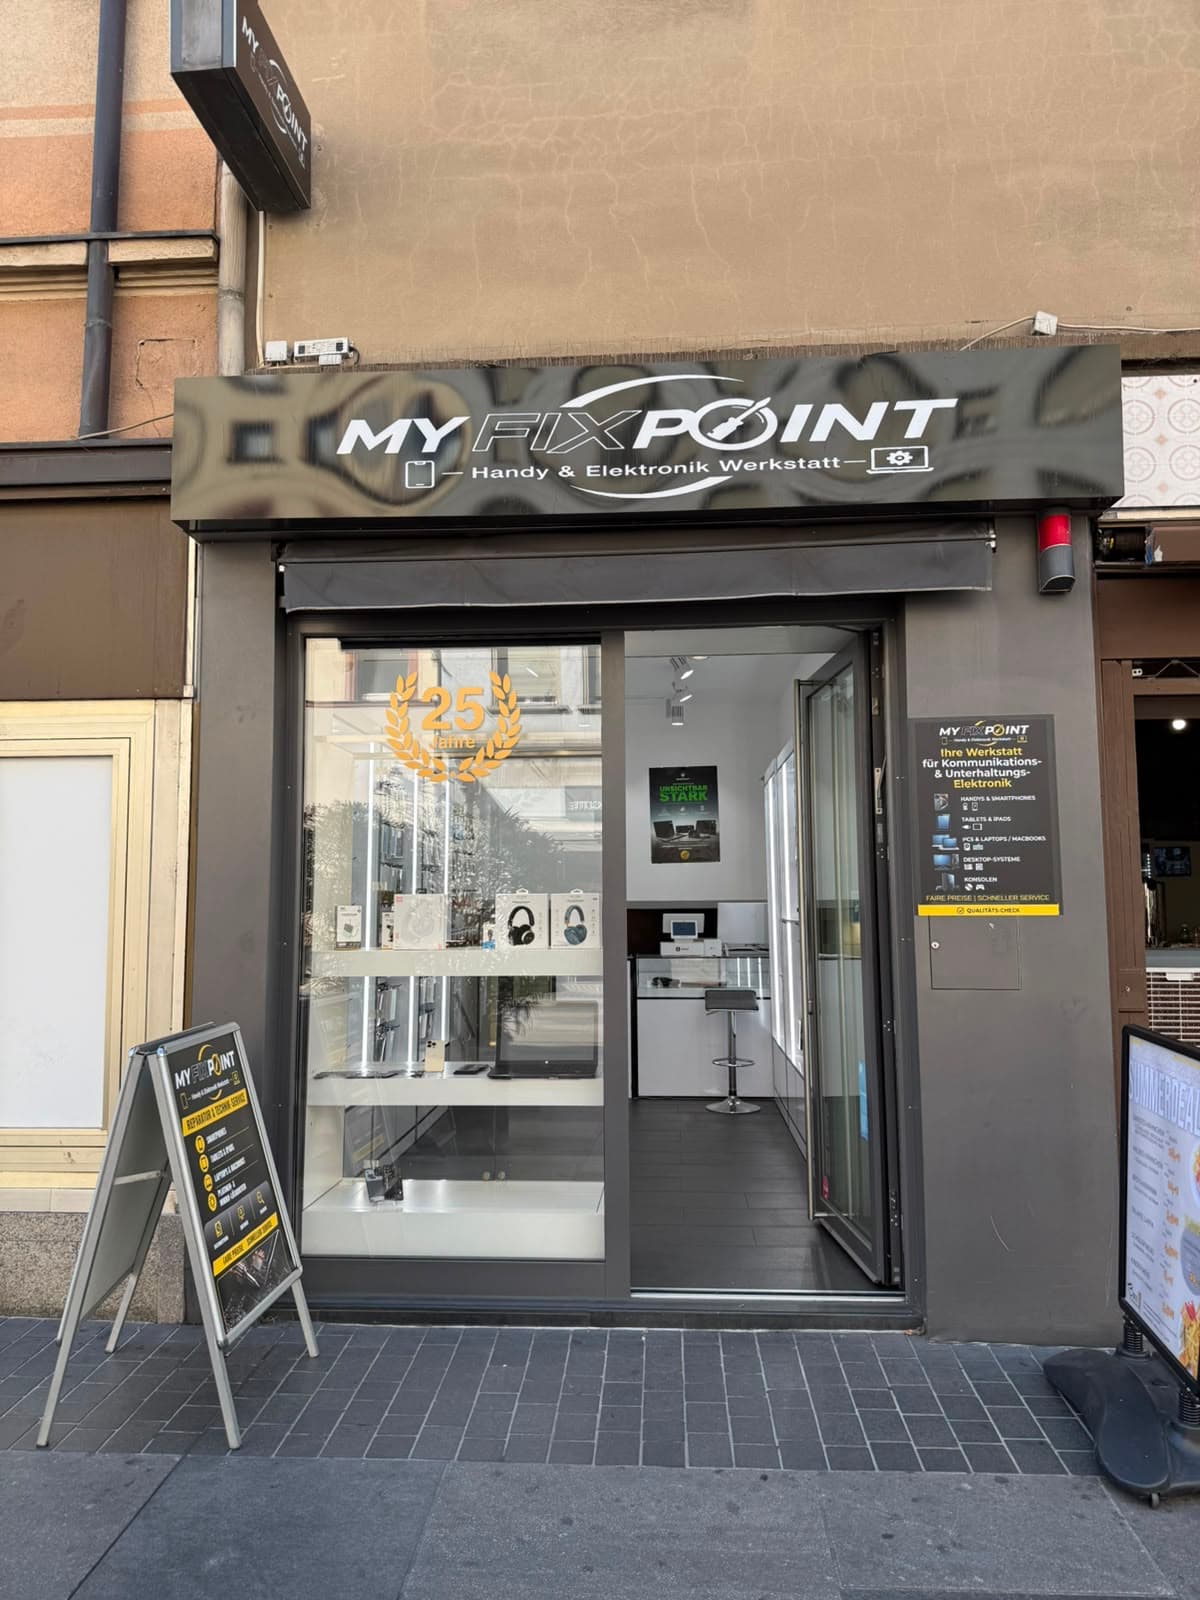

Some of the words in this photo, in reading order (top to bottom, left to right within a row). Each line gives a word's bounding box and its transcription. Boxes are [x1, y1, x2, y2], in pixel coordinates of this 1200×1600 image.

[471, 464, 549, 480] Handy
[558, 464, 572, 478] &
[586, 459, 708, 478] Elektronik
[719, 455, 841, 472] Werkstatt
[420, 687, 485, 731] 25
[430, 735, 477, 750] Jahre
[940, 748, 963, 758] Ihre
[966, 747, 1023, 757] Werkstatt
[922, 759, 939, 768] für
[941, 757, 1043, 768] Kommunikations-
[934, 769, 943, 778] &
[945, 768, 1031, 779] Unterhaltungs-
[953, 779, 1012, 789] Elektronik
[659, 791, 708, 802] STARK
